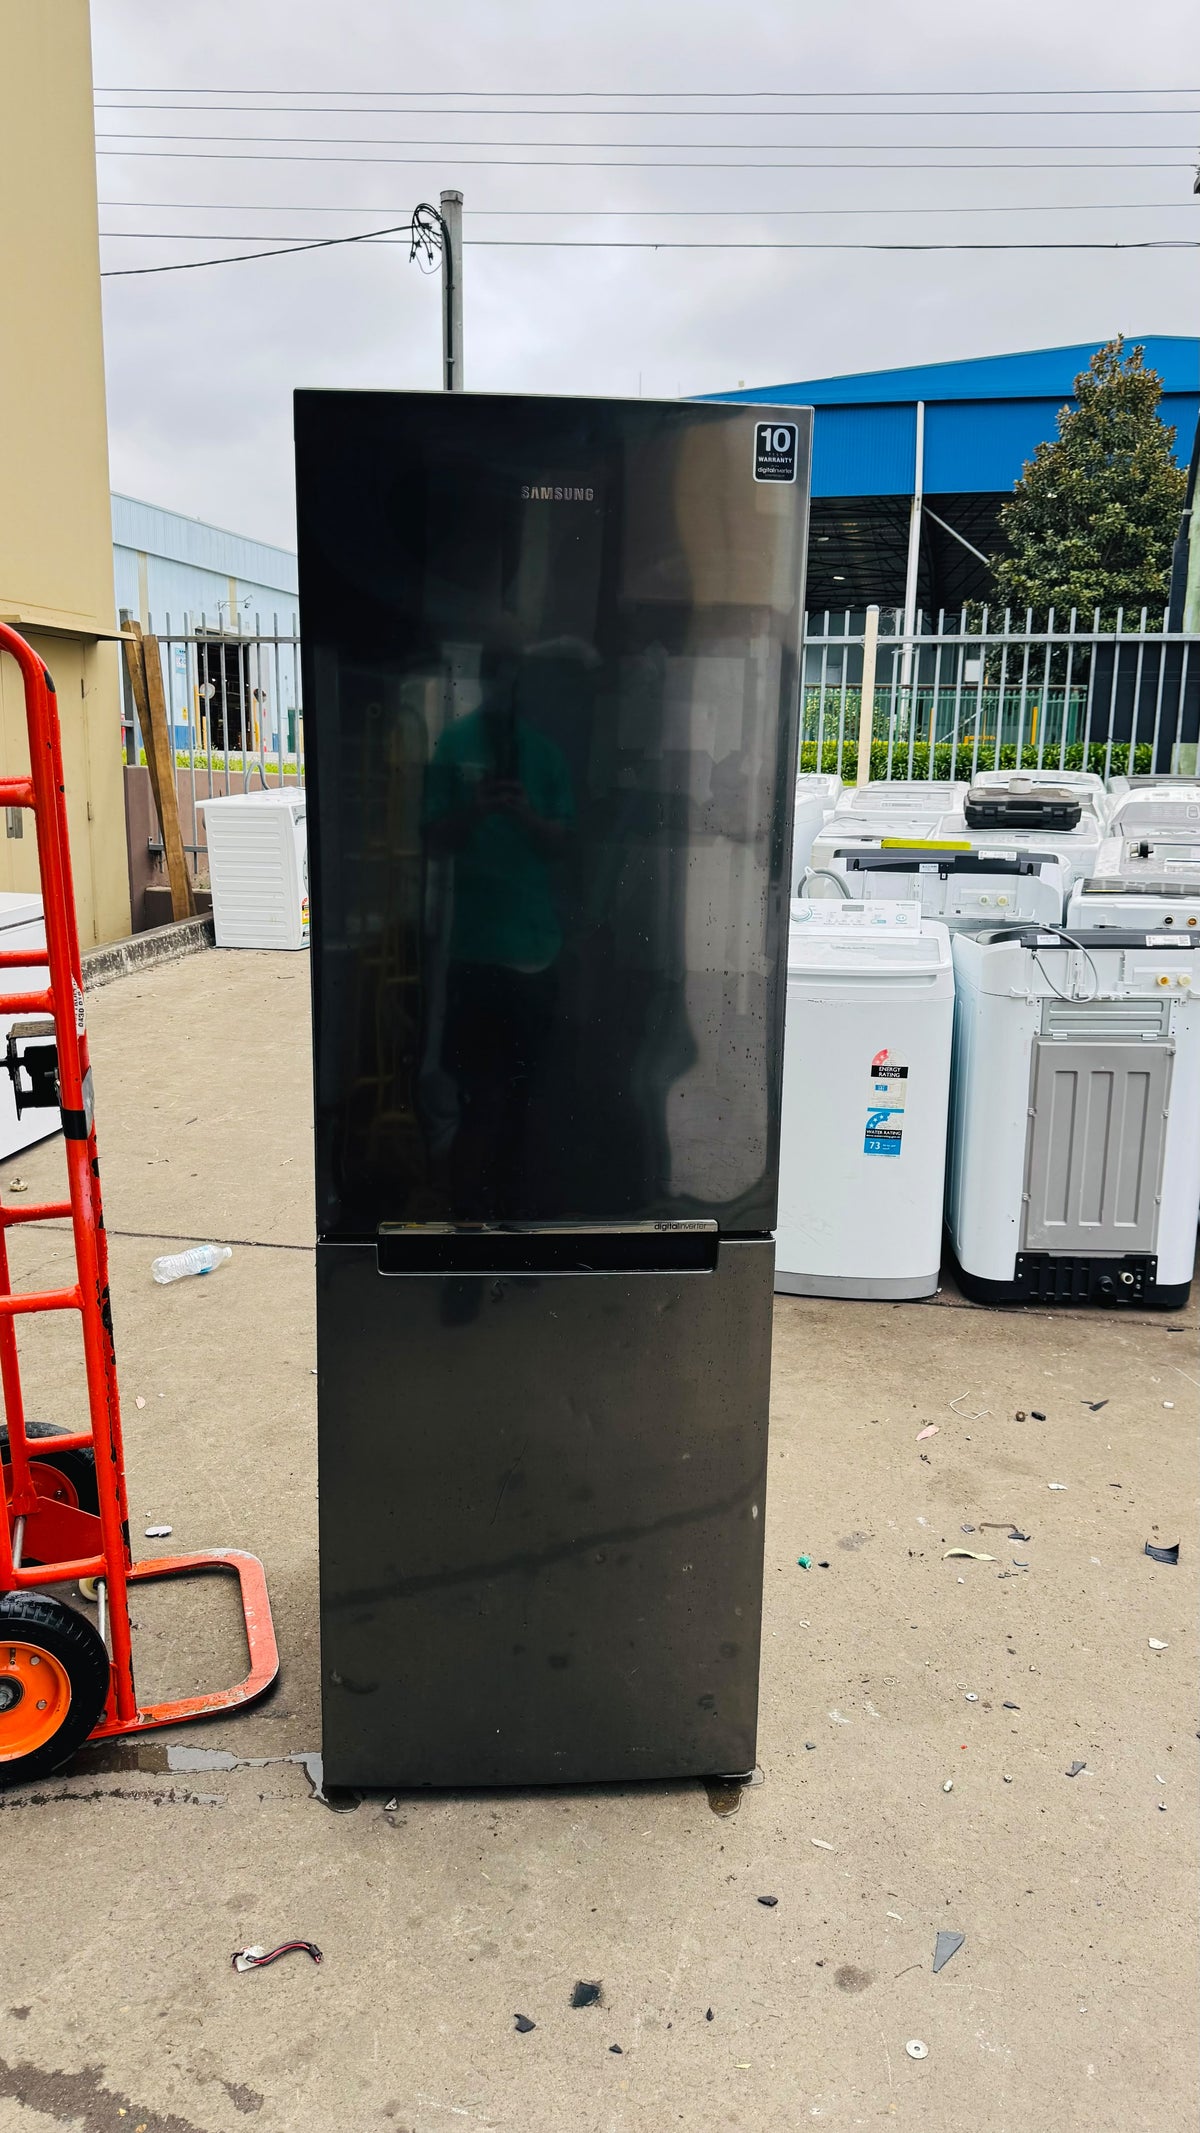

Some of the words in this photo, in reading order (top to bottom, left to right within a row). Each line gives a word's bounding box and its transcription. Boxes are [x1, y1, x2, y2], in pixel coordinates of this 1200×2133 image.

[761, 428, 791, 452] 10
[521, 485, 594, 501] SAMSUNG
[869, 1141, 881, 1150] 73
